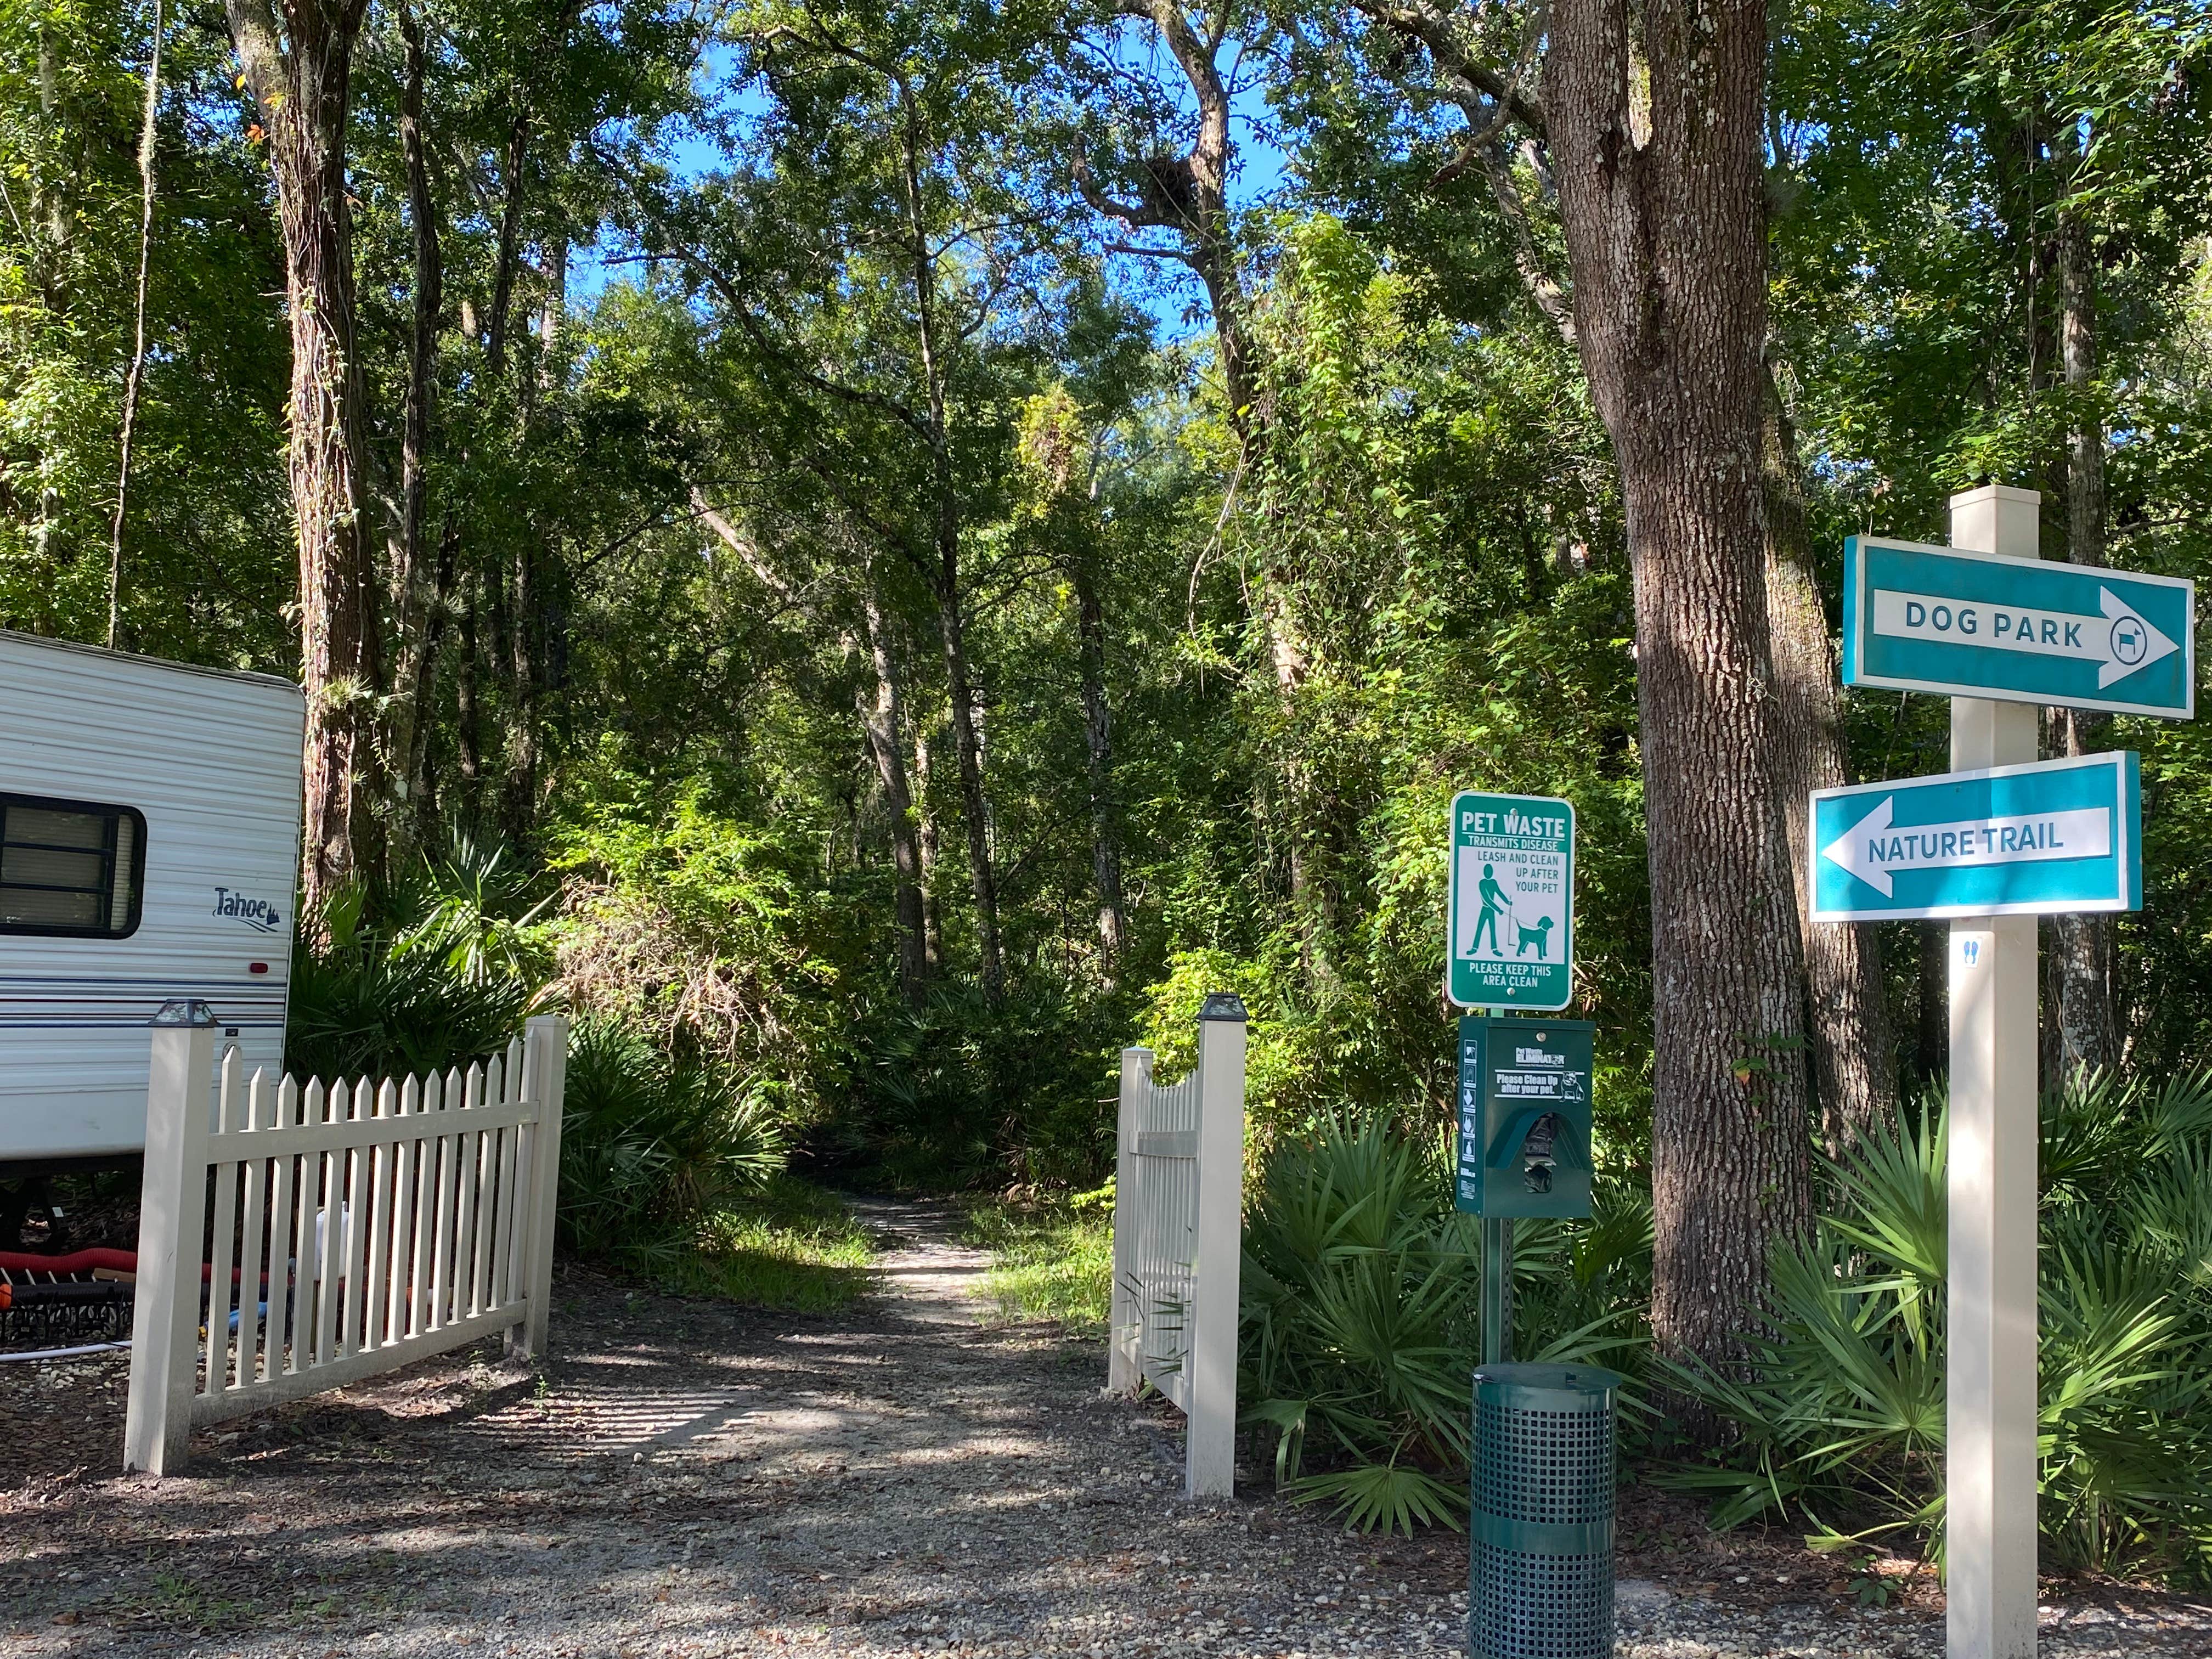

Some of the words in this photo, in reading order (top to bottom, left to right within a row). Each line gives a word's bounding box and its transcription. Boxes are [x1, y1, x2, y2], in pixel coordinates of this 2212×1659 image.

[1906, 601, 1977, 634] DOG
[1994, 613, 2082, 648] PARK
[1462, 811, 1497, 833] PET
[1503, 814, 1565, 838] WASTE
[1468, 835, 1519, 849] TRANSMITS
[1521, 839, 1558, 851] DISEASE
[1869, 830, 1975, 863] NATURE
[1982, 822, 2064, 854] TRAIL
[1478, 851, 1506, 862] LEASH
[1509, 853, 1527, 864] AND
[1530, 854, 1559, 866] CLEAN
[1516, 867, 1528, 878] UP
[1531, 868, 1559, 879] AFTER
[1515, 881, 1539, 893] YOUR
[1542, 883, 1559, 894] PET
[215, 887, 267, 918] Tahoe
[1469, 962, 1503, 974] PLEASE
[1506, 964, 1529, 975] KEEP
[1531, 965, 1551, 977] THIS
[1482, 974, 1506, 986] AREA
[1509, 976, 1538, 988] CLEAN
[1497, 1074, 1523, 1084] Please
[1524, 1074, 1547, 1085] Clean
[1547, 1075, 1558, 1086] Up
[1501, 1084, 1521, 1093] after
[1521, 1085, 1539, 1094] your
[1539, 1086, 1555, 1094] pet.
